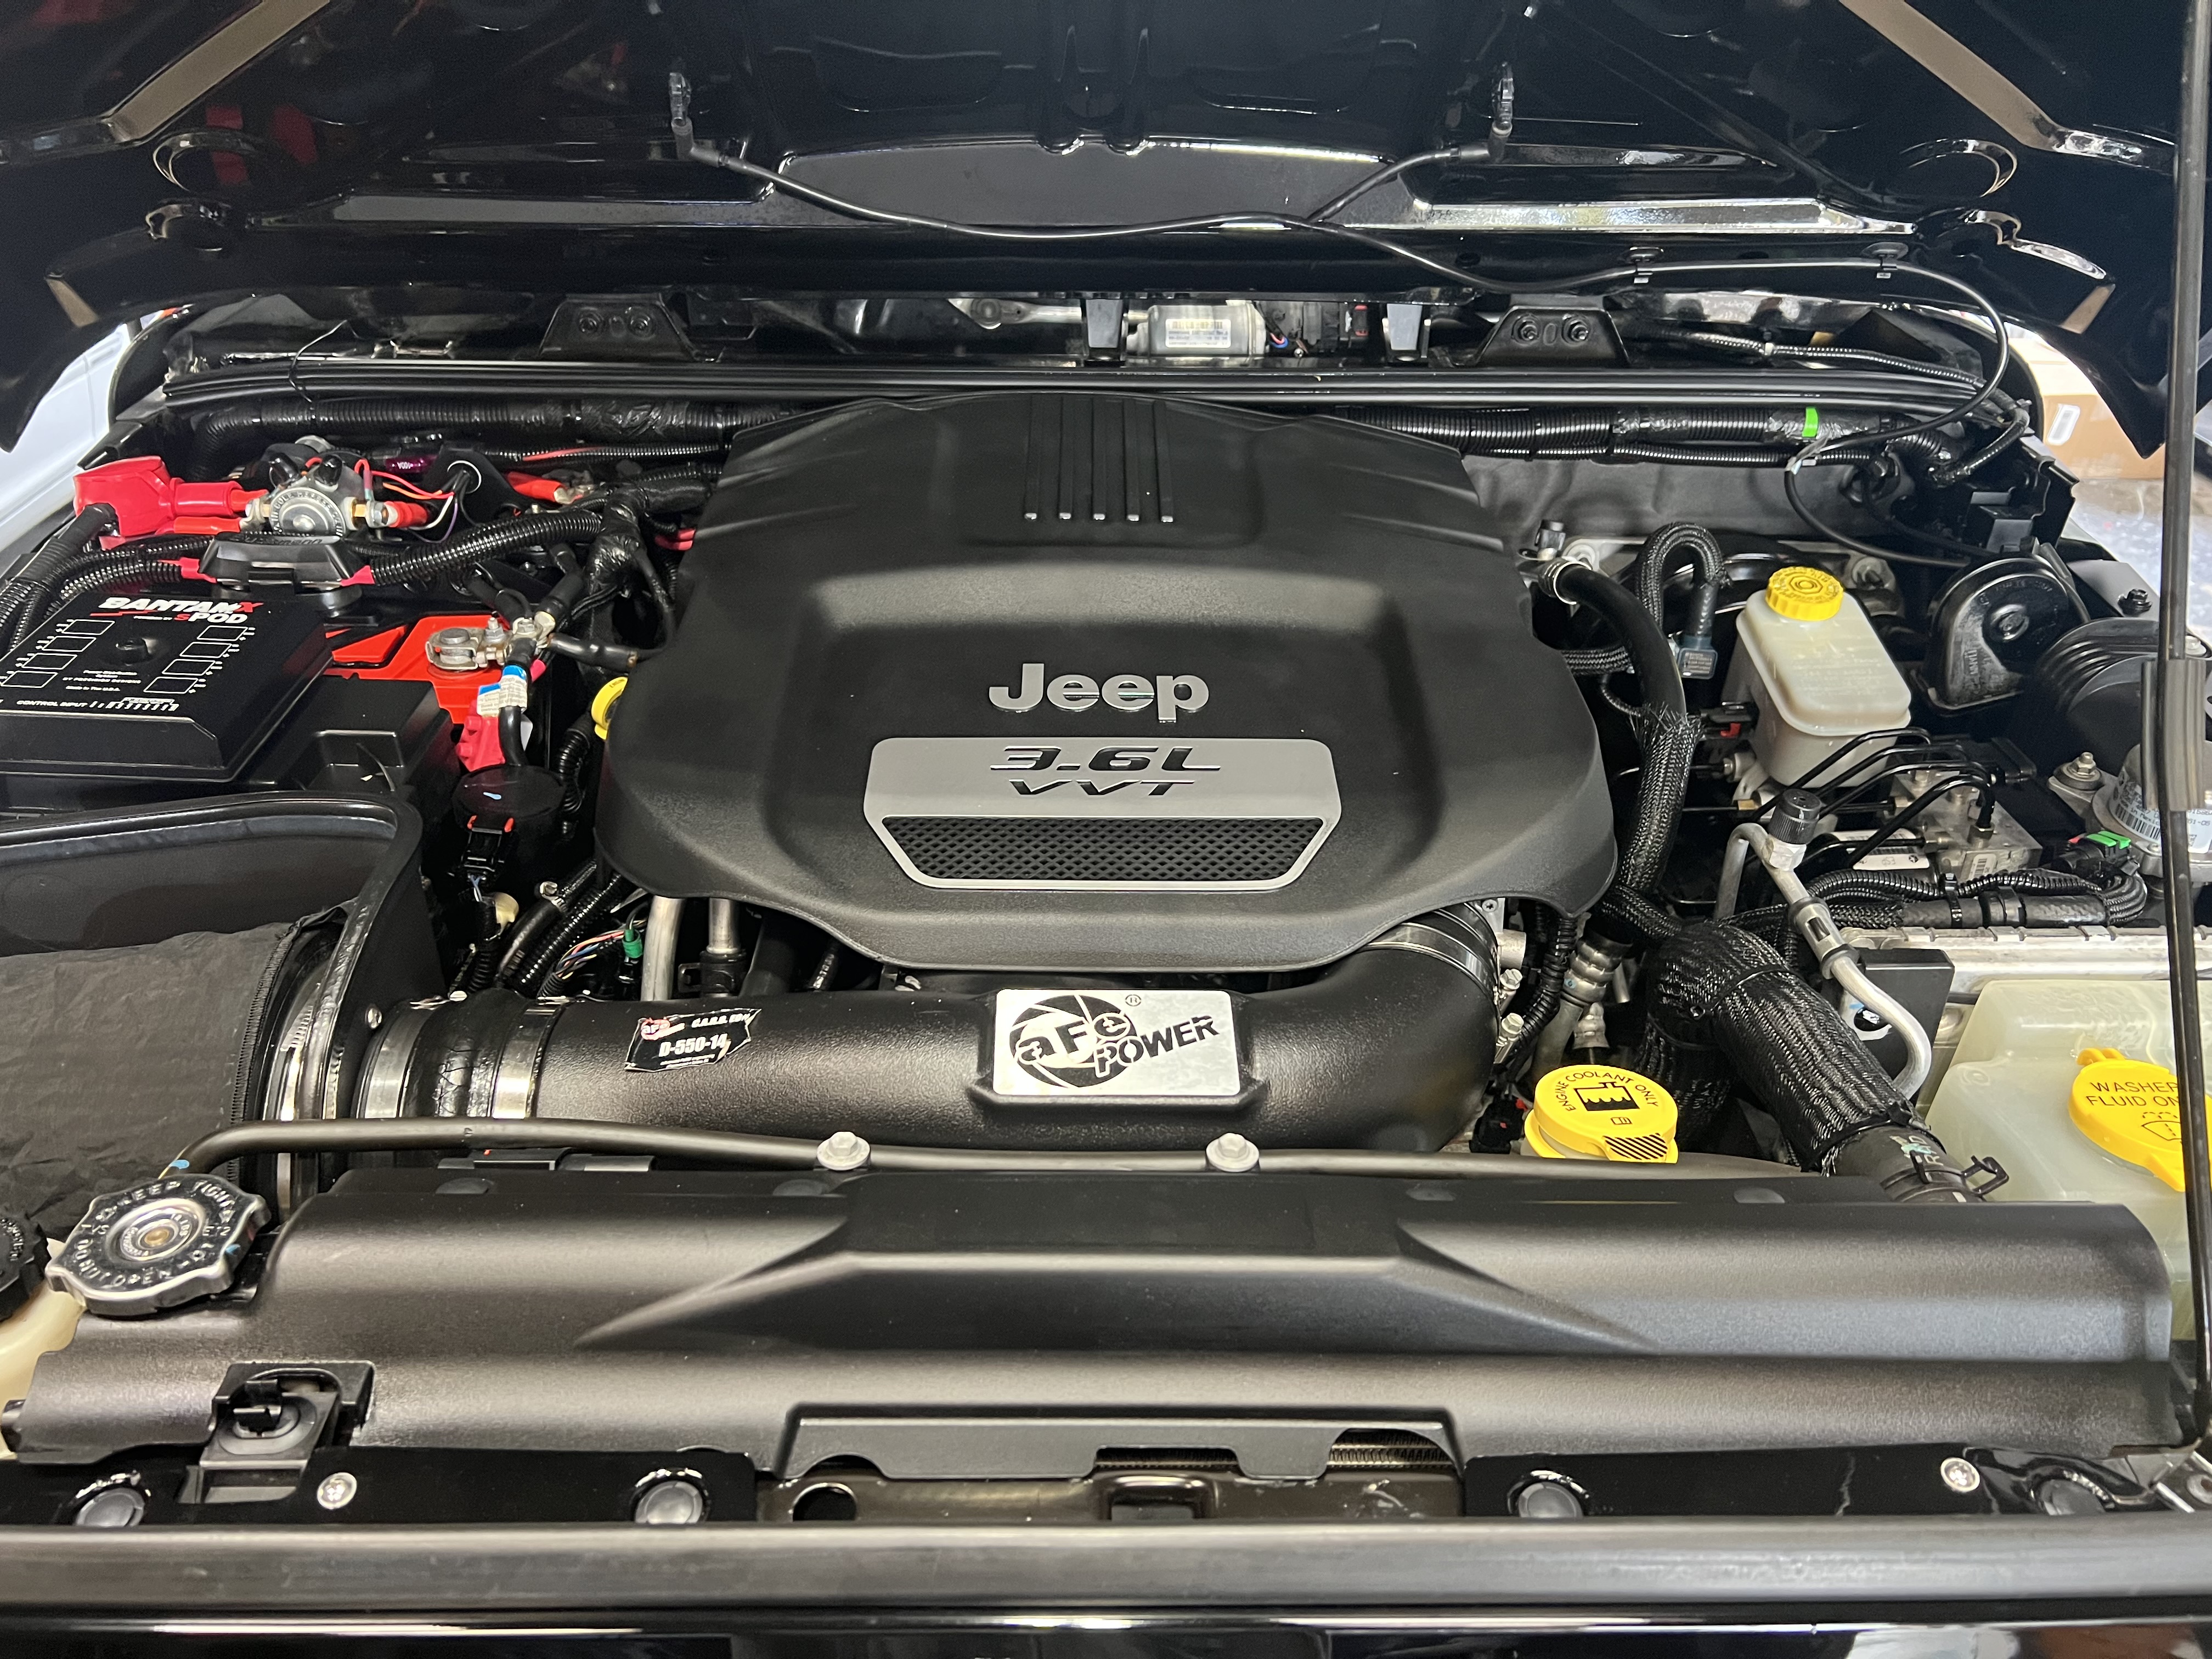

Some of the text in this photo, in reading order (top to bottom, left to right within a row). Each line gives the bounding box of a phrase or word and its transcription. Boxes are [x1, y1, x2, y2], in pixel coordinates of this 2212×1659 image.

[989, 663, 1209, 723] Jeep
[990, 746, 1221, 771] 3.6L
[1009, 779, 1195, 795] VVT
[658, 1033, 728, 1057] D-550-14
[1094, 1015, 1220, 1079] POWER
[1555, 1070, 1659, 1111] ENGINE COOLANT ONLY
[2086, 1096, 2147, 1107] FLUID
